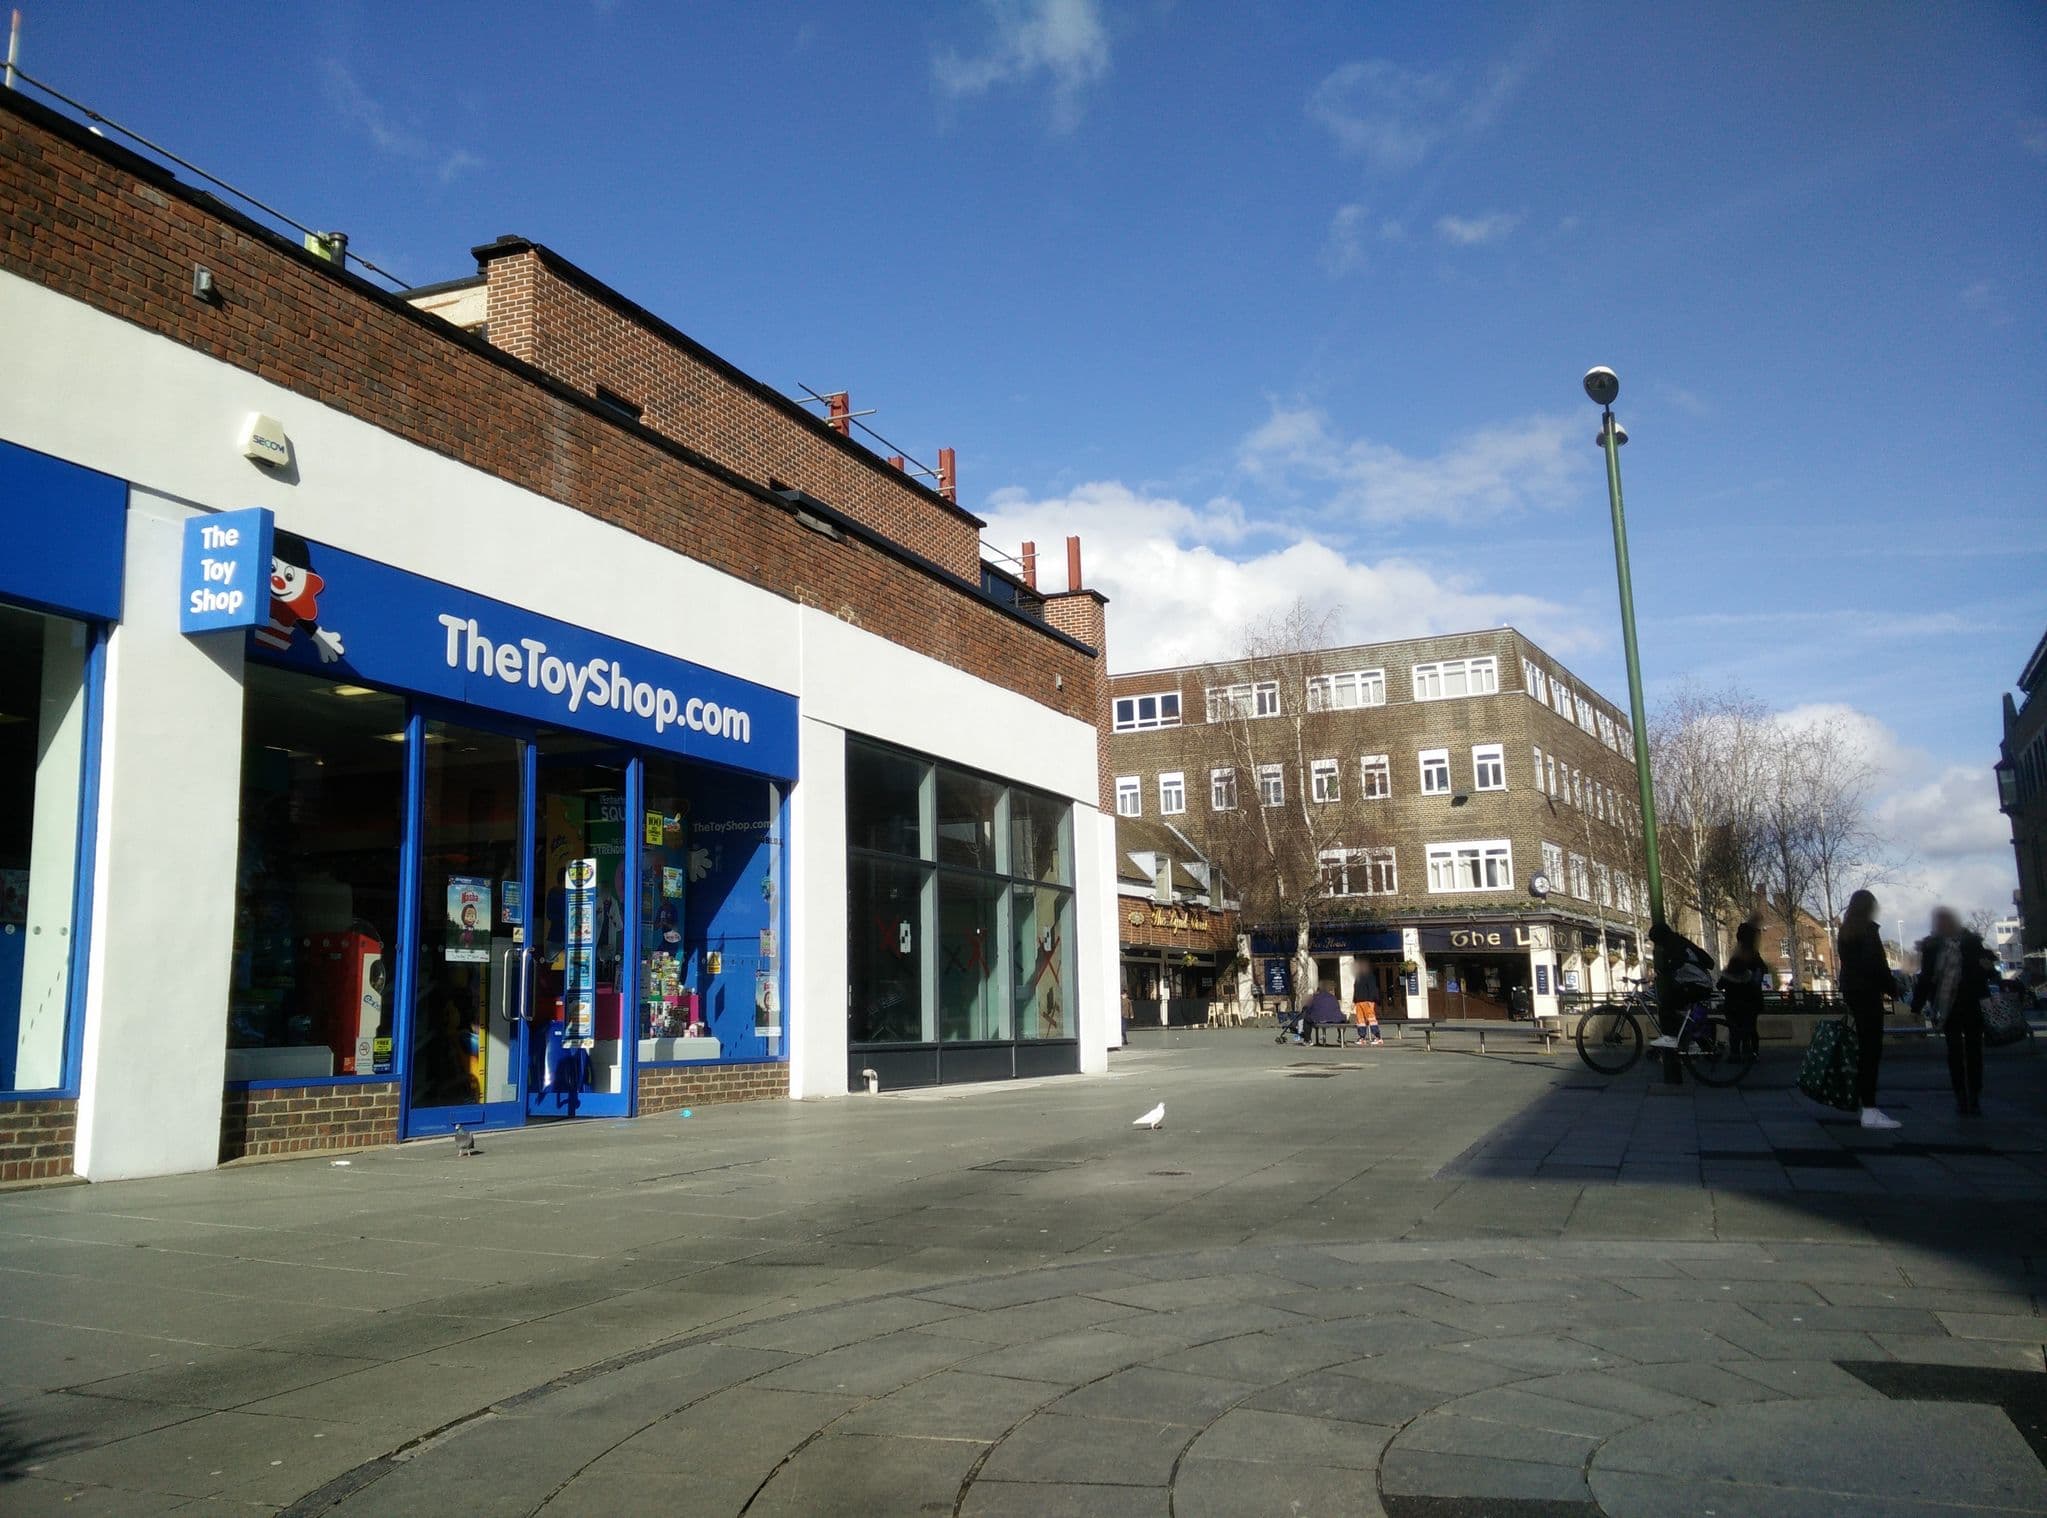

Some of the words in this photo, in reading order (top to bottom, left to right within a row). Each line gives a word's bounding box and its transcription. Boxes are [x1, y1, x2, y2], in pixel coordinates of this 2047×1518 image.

[252, 434, 285, 454] SECOM
[200, 525, 240, 550] The
[200, 558, 237, 585] Toy
[189, 587, 244, 615] Shop
[438, 613, 751, 744] TheToyShop.com
[693, 818, 773, 834] TheToyShop.com
[1450, 929, 1502, 948] The
